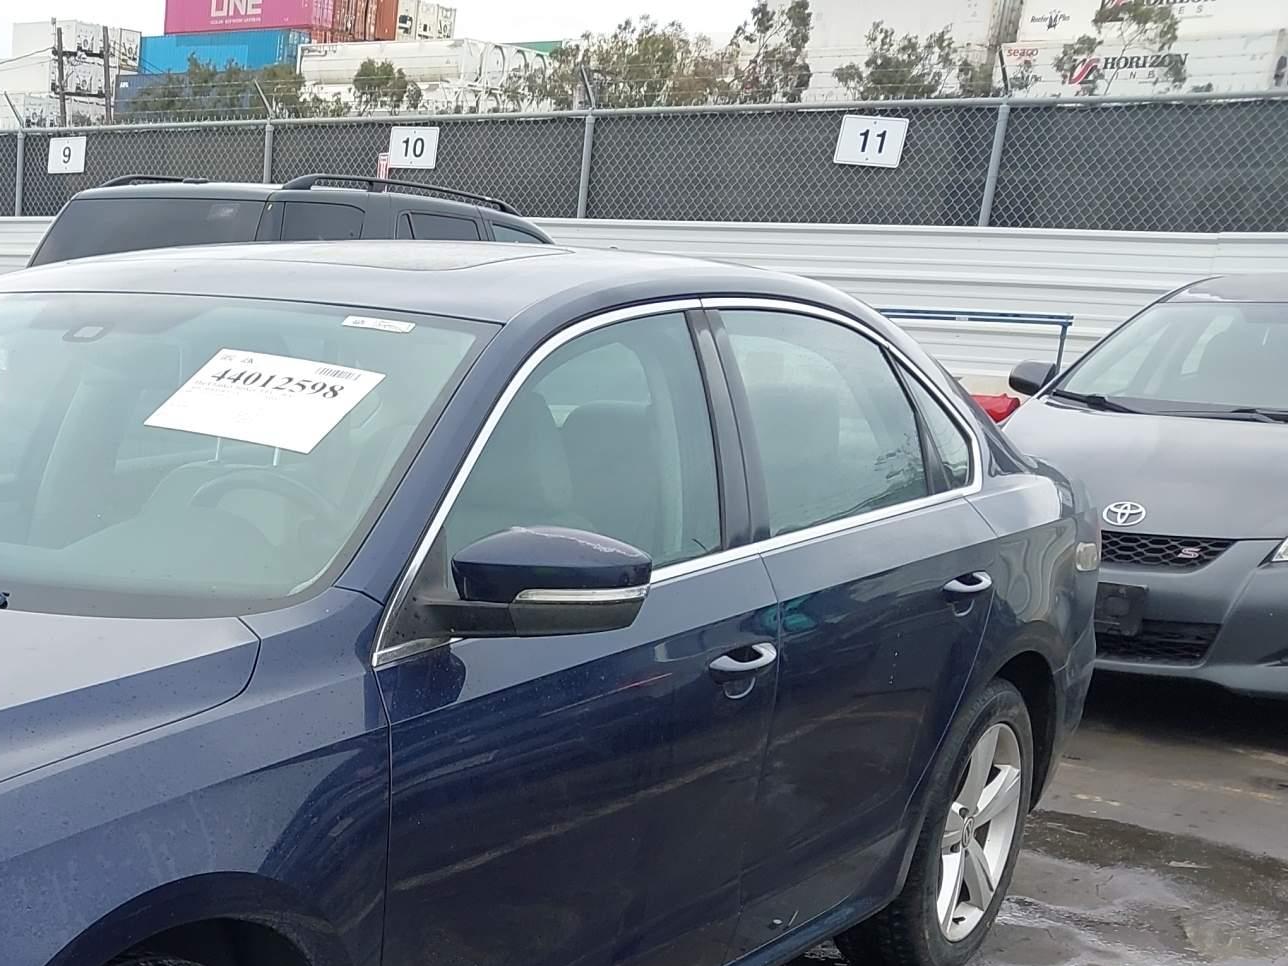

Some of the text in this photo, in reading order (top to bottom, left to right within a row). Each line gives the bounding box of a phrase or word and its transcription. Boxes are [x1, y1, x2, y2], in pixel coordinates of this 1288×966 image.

[1103, 52, 1189, 70] HORIZON
[402, 137, 425, 158] 10
[859, 128, 887, 154] 11
[62, 146, 72, 164] 9
[211, 368, 345, 399] 44012598
